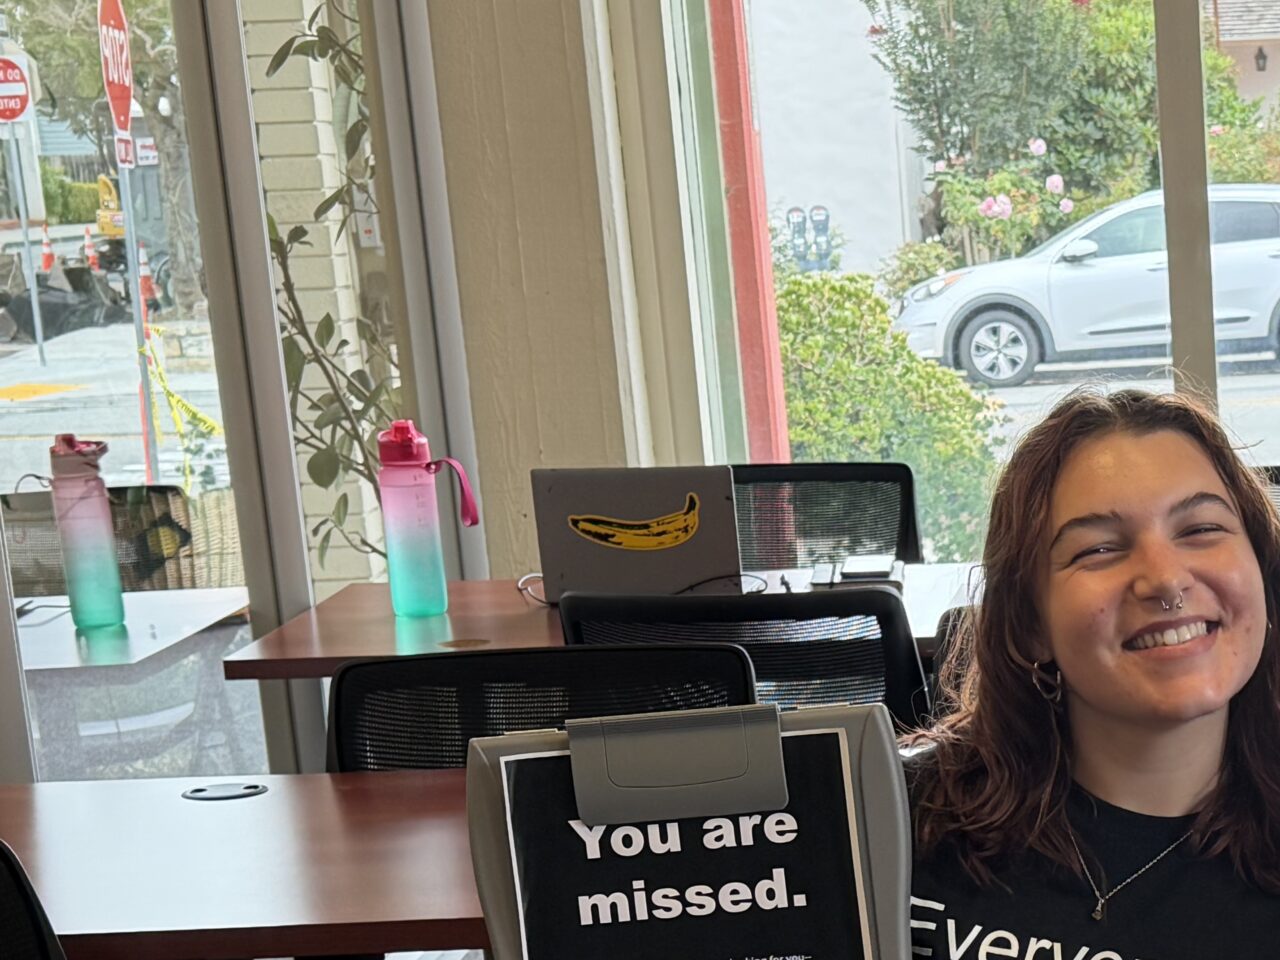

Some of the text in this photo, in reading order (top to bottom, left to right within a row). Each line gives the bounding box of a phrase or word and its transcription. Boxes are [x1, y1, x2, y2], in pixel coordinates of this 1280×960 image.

[567, 811, 798, 860] You are
[577, 867, 808, 926] missed.
